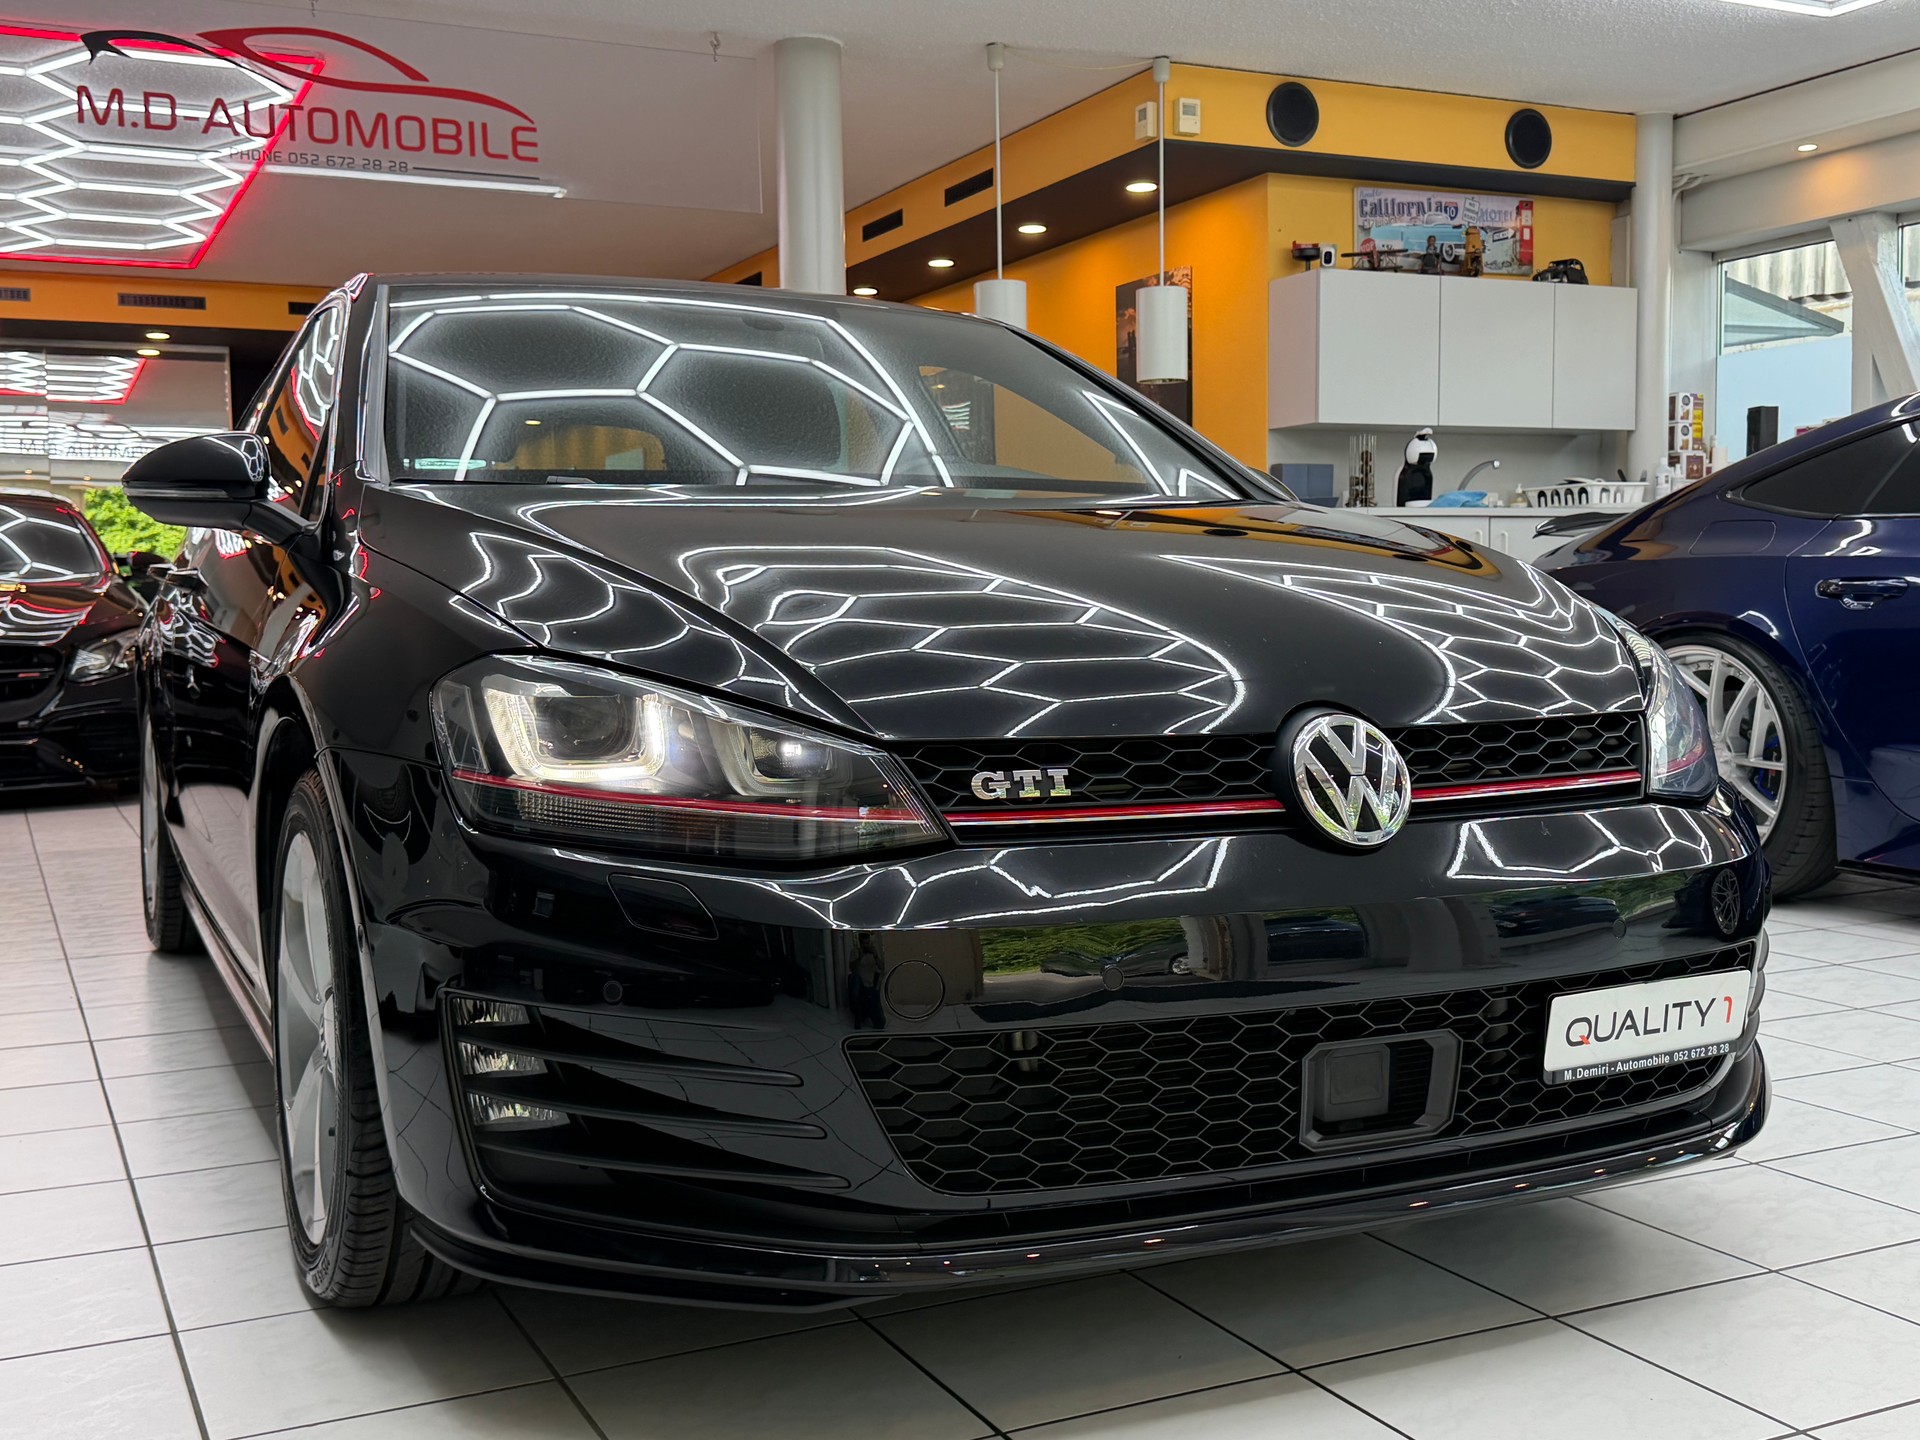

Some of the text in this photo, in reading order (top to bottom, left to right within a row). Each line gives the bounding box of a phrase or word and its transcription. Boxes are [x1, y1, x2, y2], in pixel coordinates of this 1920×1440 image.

[1360, 198, 1442, 217] California
[1446, 207, 1456, 217] 10
[970, 768, 1072, 800] GTI
[1565, 995, 1733, 1047] QUALITY 1
[1616, 1055, 1670, 1072] Automobile
[1673, 1050, 1689, 1062] 052
[1691, 1048, 1706, 1059] 672
[1708, 1045, 1718, 1056] 28
[1719, 1042, 1730, 1053] 28
